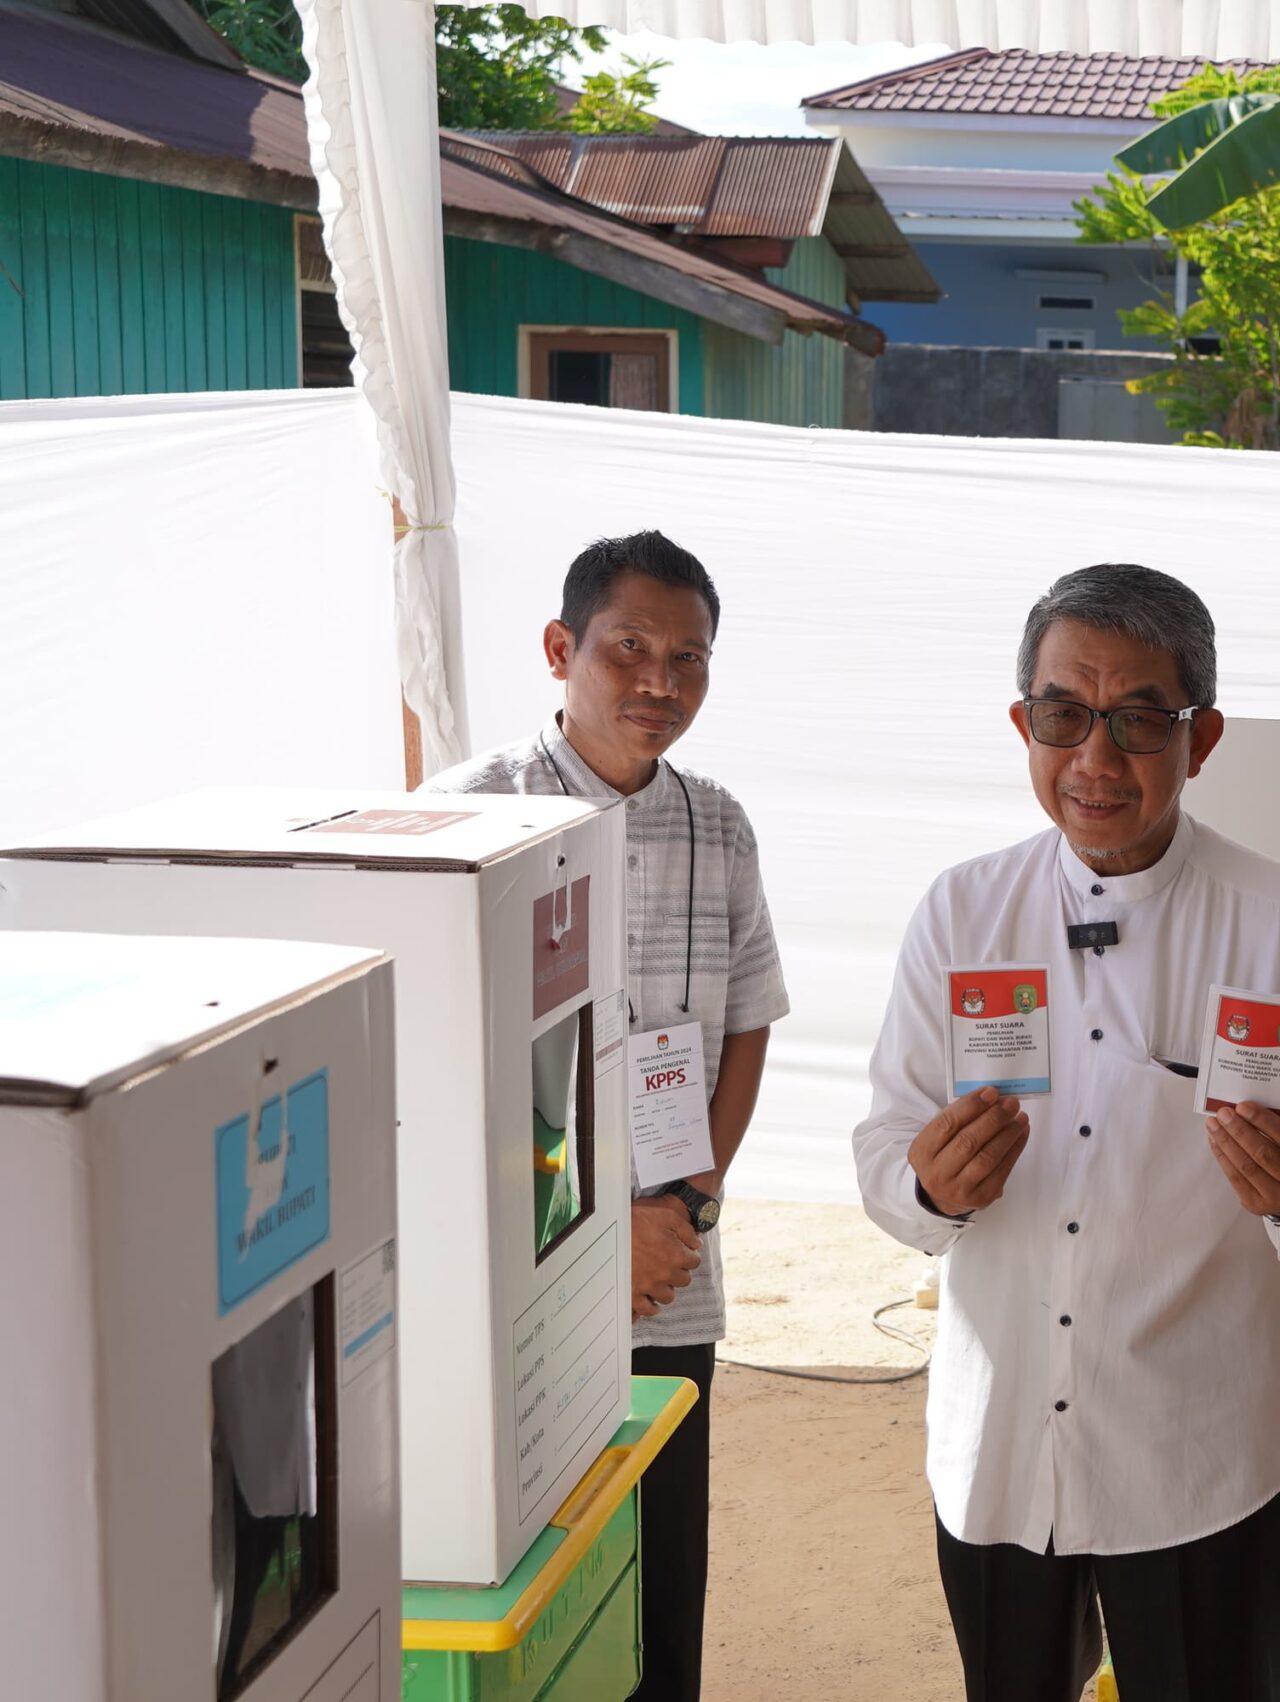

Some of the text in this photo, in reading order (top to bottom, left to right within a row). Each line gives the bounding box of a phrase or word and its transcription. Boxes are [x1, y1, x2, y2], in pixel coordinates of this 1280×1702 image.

[636, 1054, 662, 1063] PEMILIHAN
[1236, 1049, 1257, 1058] SURAT
[640, 1058, 690, 1074] TANDA PENGENAL
[645, 1068, 686, 1091] KPPS
[277, 1184, 315, 1227] BUPATI
[534, 1318, 544, 1337] TPS
[517, 1353, 544, 1392] Lokasi PPS
[518, 1402, 535, 1427] Lokasi
[522, 1462, 543, 1496] Provinsi
